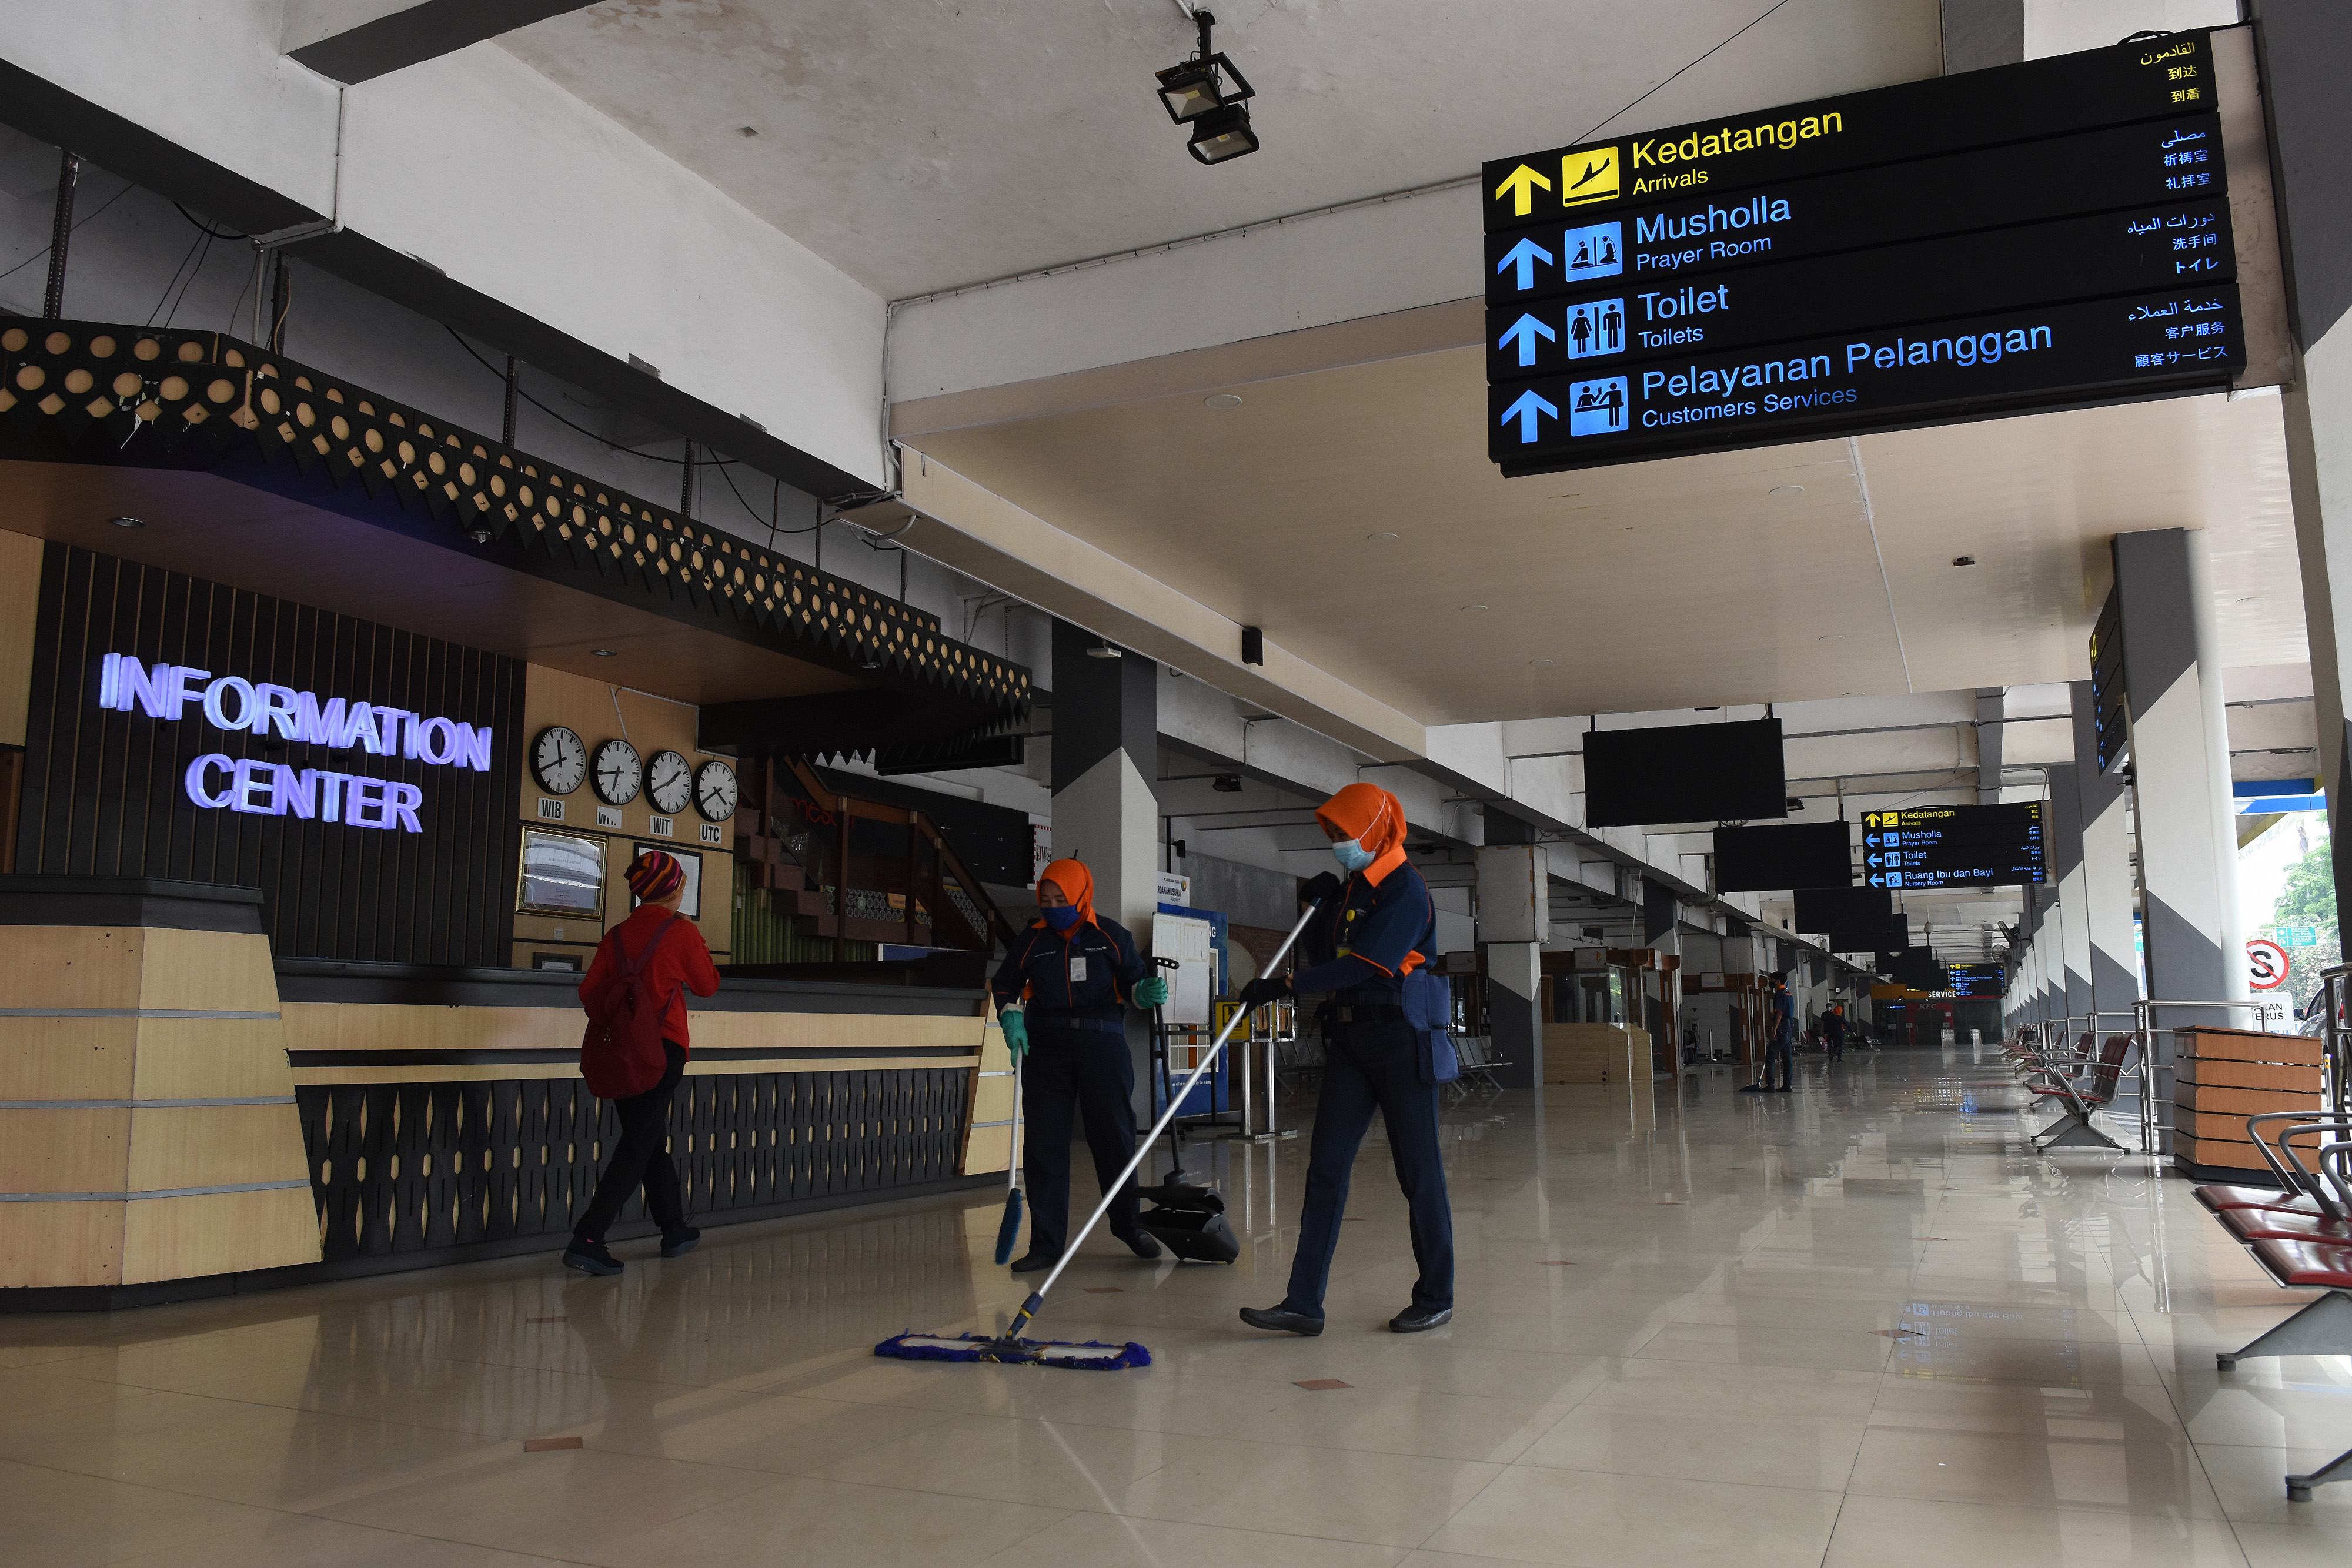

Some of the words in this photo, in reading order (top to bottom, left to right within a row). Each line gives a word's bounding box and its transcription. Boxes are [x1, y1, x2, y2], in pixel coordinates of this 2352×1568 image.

[2141, 42, 2196, 65] القادمون
[2167, 65, 2198, 81] 到达
[2171, 88, 2200, 103] 到着
[1633, 112, 1843, 169] Kedatangan
[2161, 129, 2206, 148] مصلى
[2163, 149, 2209, 166] 祈祷室
[1633, 168, 1709, 195] Arrivals
[2166, 173, 2210, 189] 礼拝室
[1636, 196, 1792, 244] Musholla
[2127, 217, 2161, 235] المياه
[2166, 213, 2214, 229] دورات
[2172, 233, 2217, 250] 洗手间
[1636, 248, 1703, 270] Prayer
[1710, 238, 1772, 258] Room
[2176, 258, 2219, 274] トイレ
[1637, 285, 1729, 320] Toilet
[2128, 302, 2179, 321] العملاء
[2184, 299, 2224, 313] خدمة
[1638, 326, 1704, 348] Toilets
[2165, 322, 2226, 339] 客户服务
[1642, 354, 1830, 400] Pelayanan
[1847, 326, 2053, 373] Pelanggan
[2134, 346, 2229, 368] 顧客サービス
[1642, 396, 1756, 428] Customers
[1763, 387, 1857, 412] Services
[99, 652, 492, 772] INFORMATION
[184, 753, 424, 833] CENTER
[541, 799, 563, 819] WIB
[1901, 810, 1955, 820] Kedatangan
[653, 818, 671, 835] WIT
[701, 825, 720, 842] UTC
[1902, 830, 1942, 840] Musholla
[1903, 851, 1927, 860] Toilet
[1905, 871, 1934, 881] Ruang
[1937, 870, 1951, 878] Ibu
[1973, 868, 1993, 878] Bayi
[2250, 951, 2274, 978] S
[2253, 1012, 2284, 1020] ERUS
